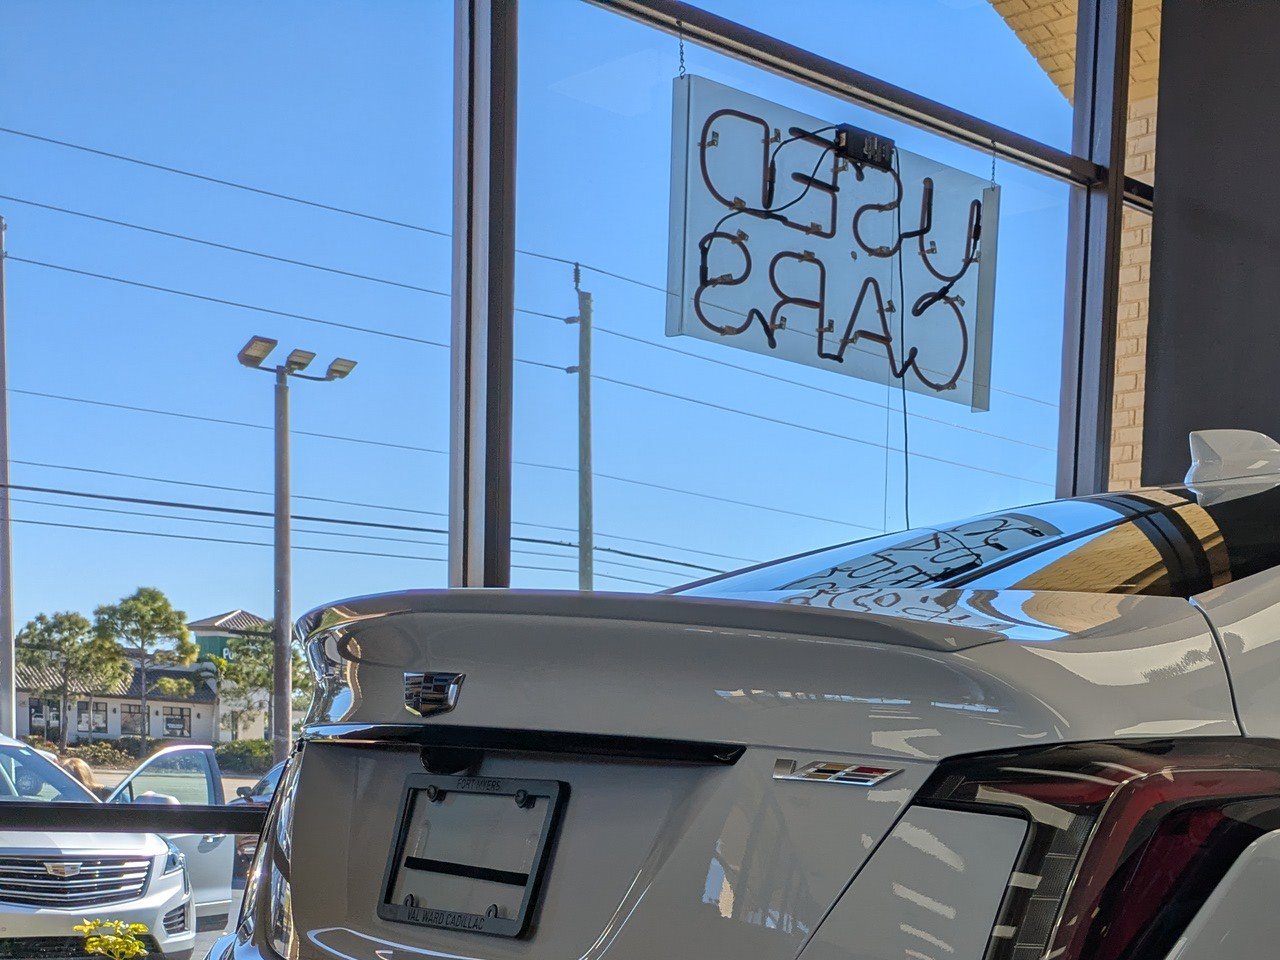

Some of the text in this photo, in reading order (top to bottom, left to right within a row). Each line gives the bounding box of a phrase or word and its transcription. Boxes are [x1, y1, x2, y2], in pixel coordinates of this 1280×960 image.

[456, 778, 476, 789] FORT
[407, 908, 485, 931] VAL WARD CADILLAC
